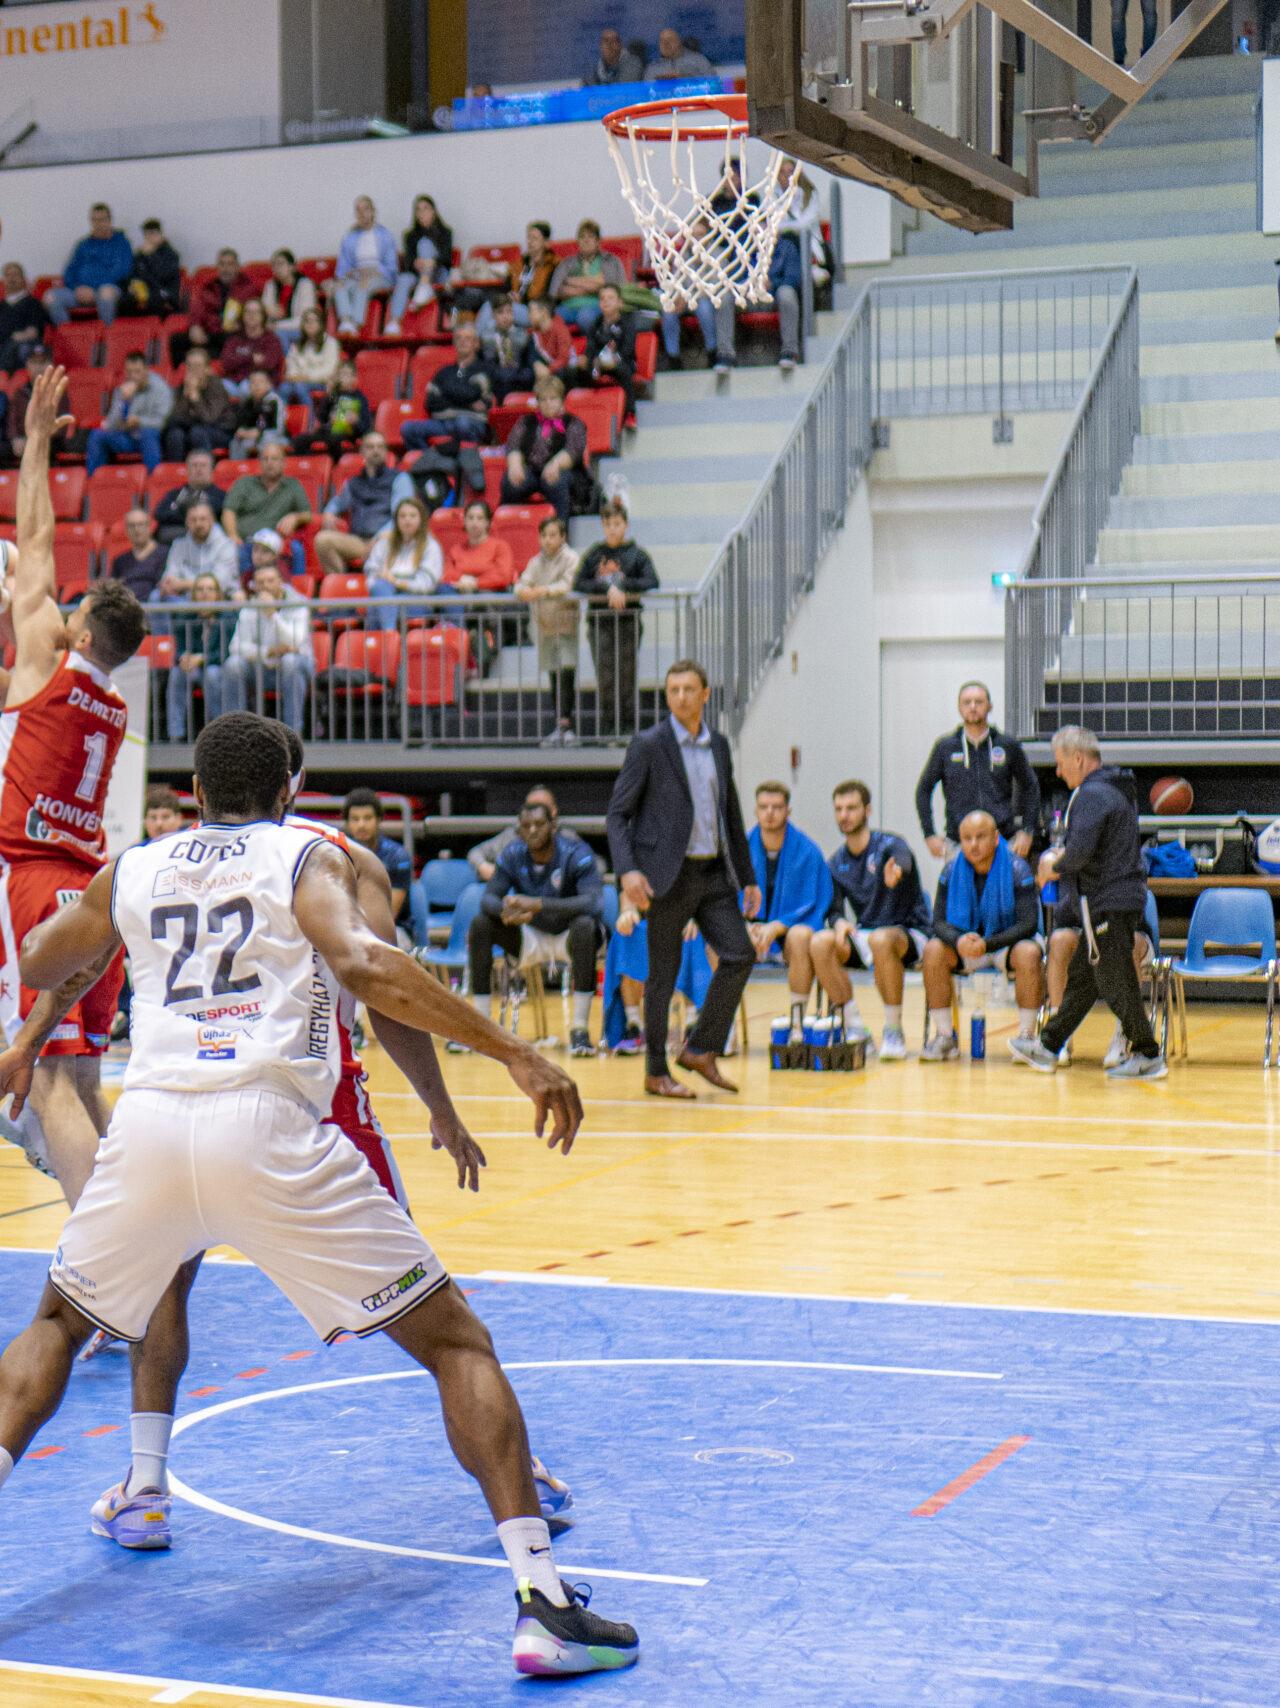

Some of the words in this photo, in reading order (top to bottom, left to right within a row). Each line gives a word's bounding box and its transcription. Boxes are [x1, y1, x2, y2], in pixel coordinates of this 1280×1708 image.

[75, 732, 107, 803] 1
[35, 793, 101, 833] HONVÉ
[151, 896, 262, 1007] 22
